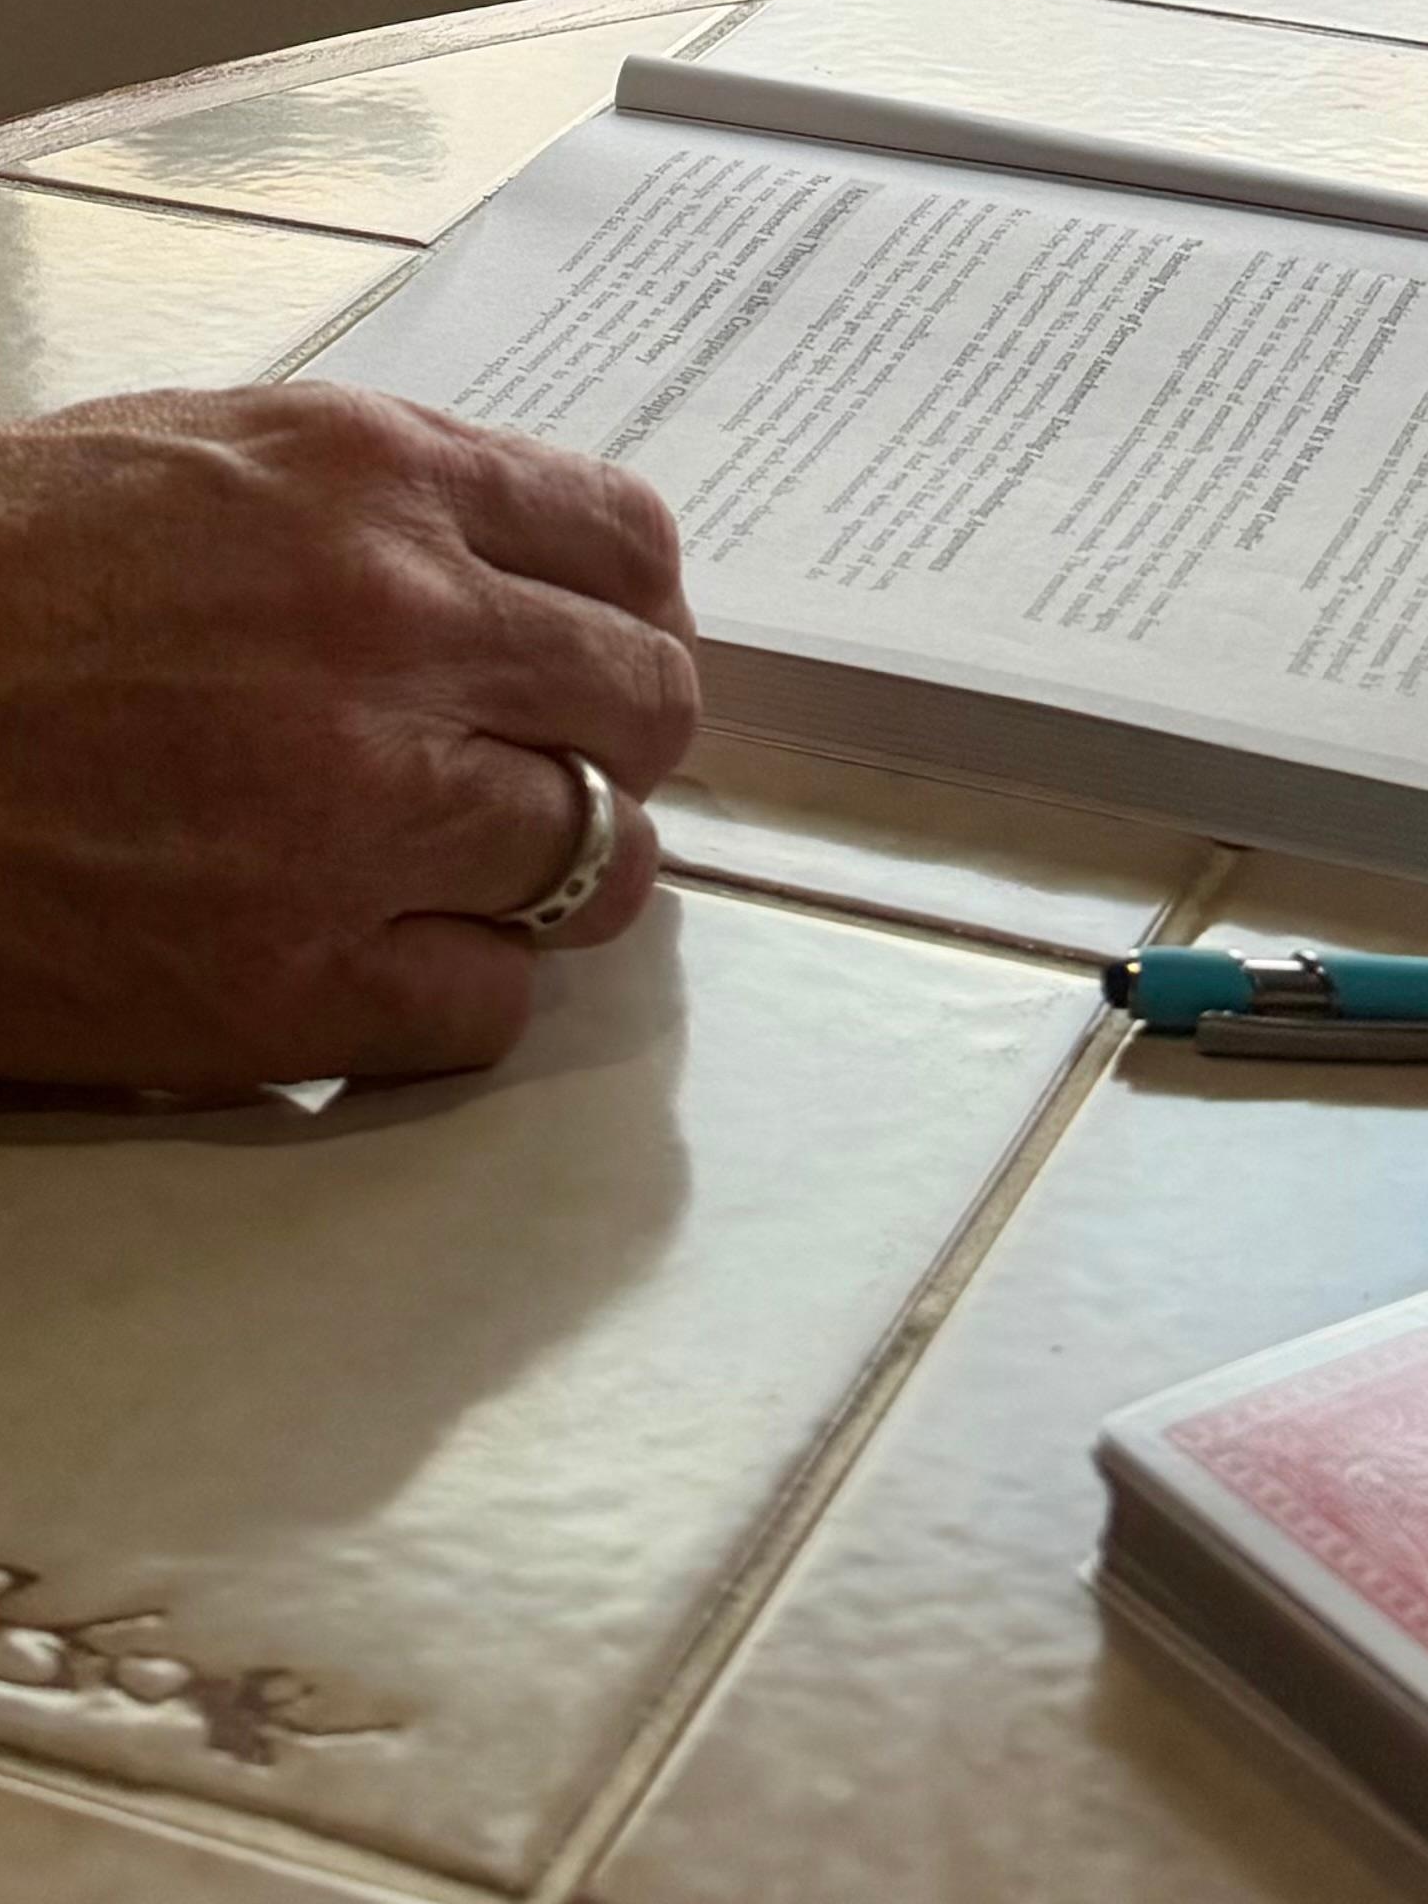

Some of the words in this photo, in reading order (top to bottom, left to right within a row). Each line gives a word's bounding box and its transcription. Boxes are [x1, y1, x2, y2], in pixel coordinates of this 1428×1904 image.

[800, 185, 869, 241] Attachment
[764, 240, 819, 280] Theory
[736, 293, 771, 316] the
[755, 278, 780, 295] as
[690, 315, 757, 367] Compass
[672, 365, 708, 385] for
[631, 384, 688, 427] Couple
[599, 426, 650, 461] Thera
